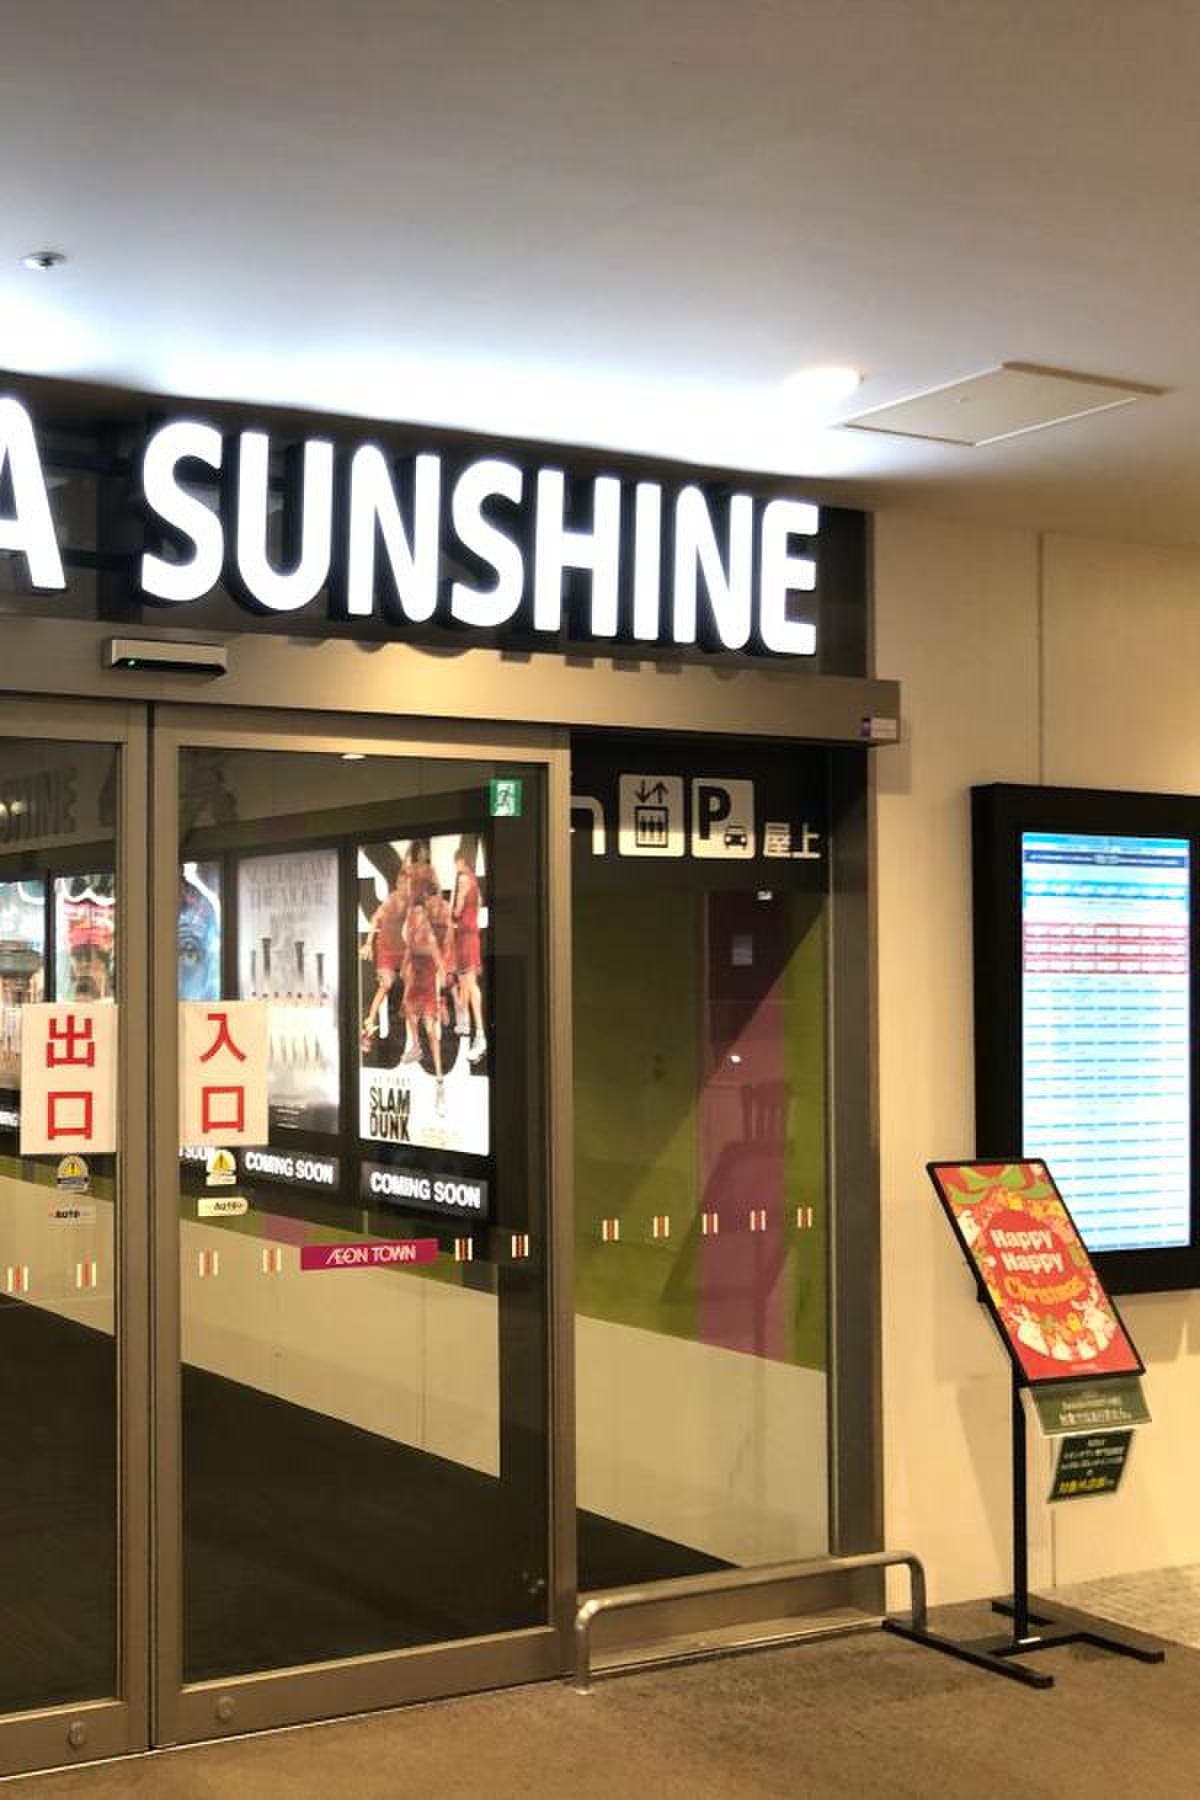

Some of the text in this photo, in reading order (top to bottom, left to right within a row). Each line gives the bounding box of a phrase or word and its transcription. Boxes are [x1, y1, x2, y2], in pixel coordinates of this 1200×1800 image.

[140, 420, 820, 657] SUNSHINE
[698, 786, 731, 840] P
[762, 822, 822, 859] 屋上
[46, 1015, 95, 1140] 出口
[199, 1013, 247, 1134] 入口
[369, 1086, 411, 1115] SLAM
[369, 1112, 411, 1142] DUNK
[245, 1151, 293, 1178] COMING
[295, 1159, 335, 1185] SOON
[369, 1171, 481, 1209] COMING SOON
[371, 1245, 417, 1262] TOWN
[989, 1228, 1054, 1251] Happy
[1001, 1251, 1065, 1275] Happy
